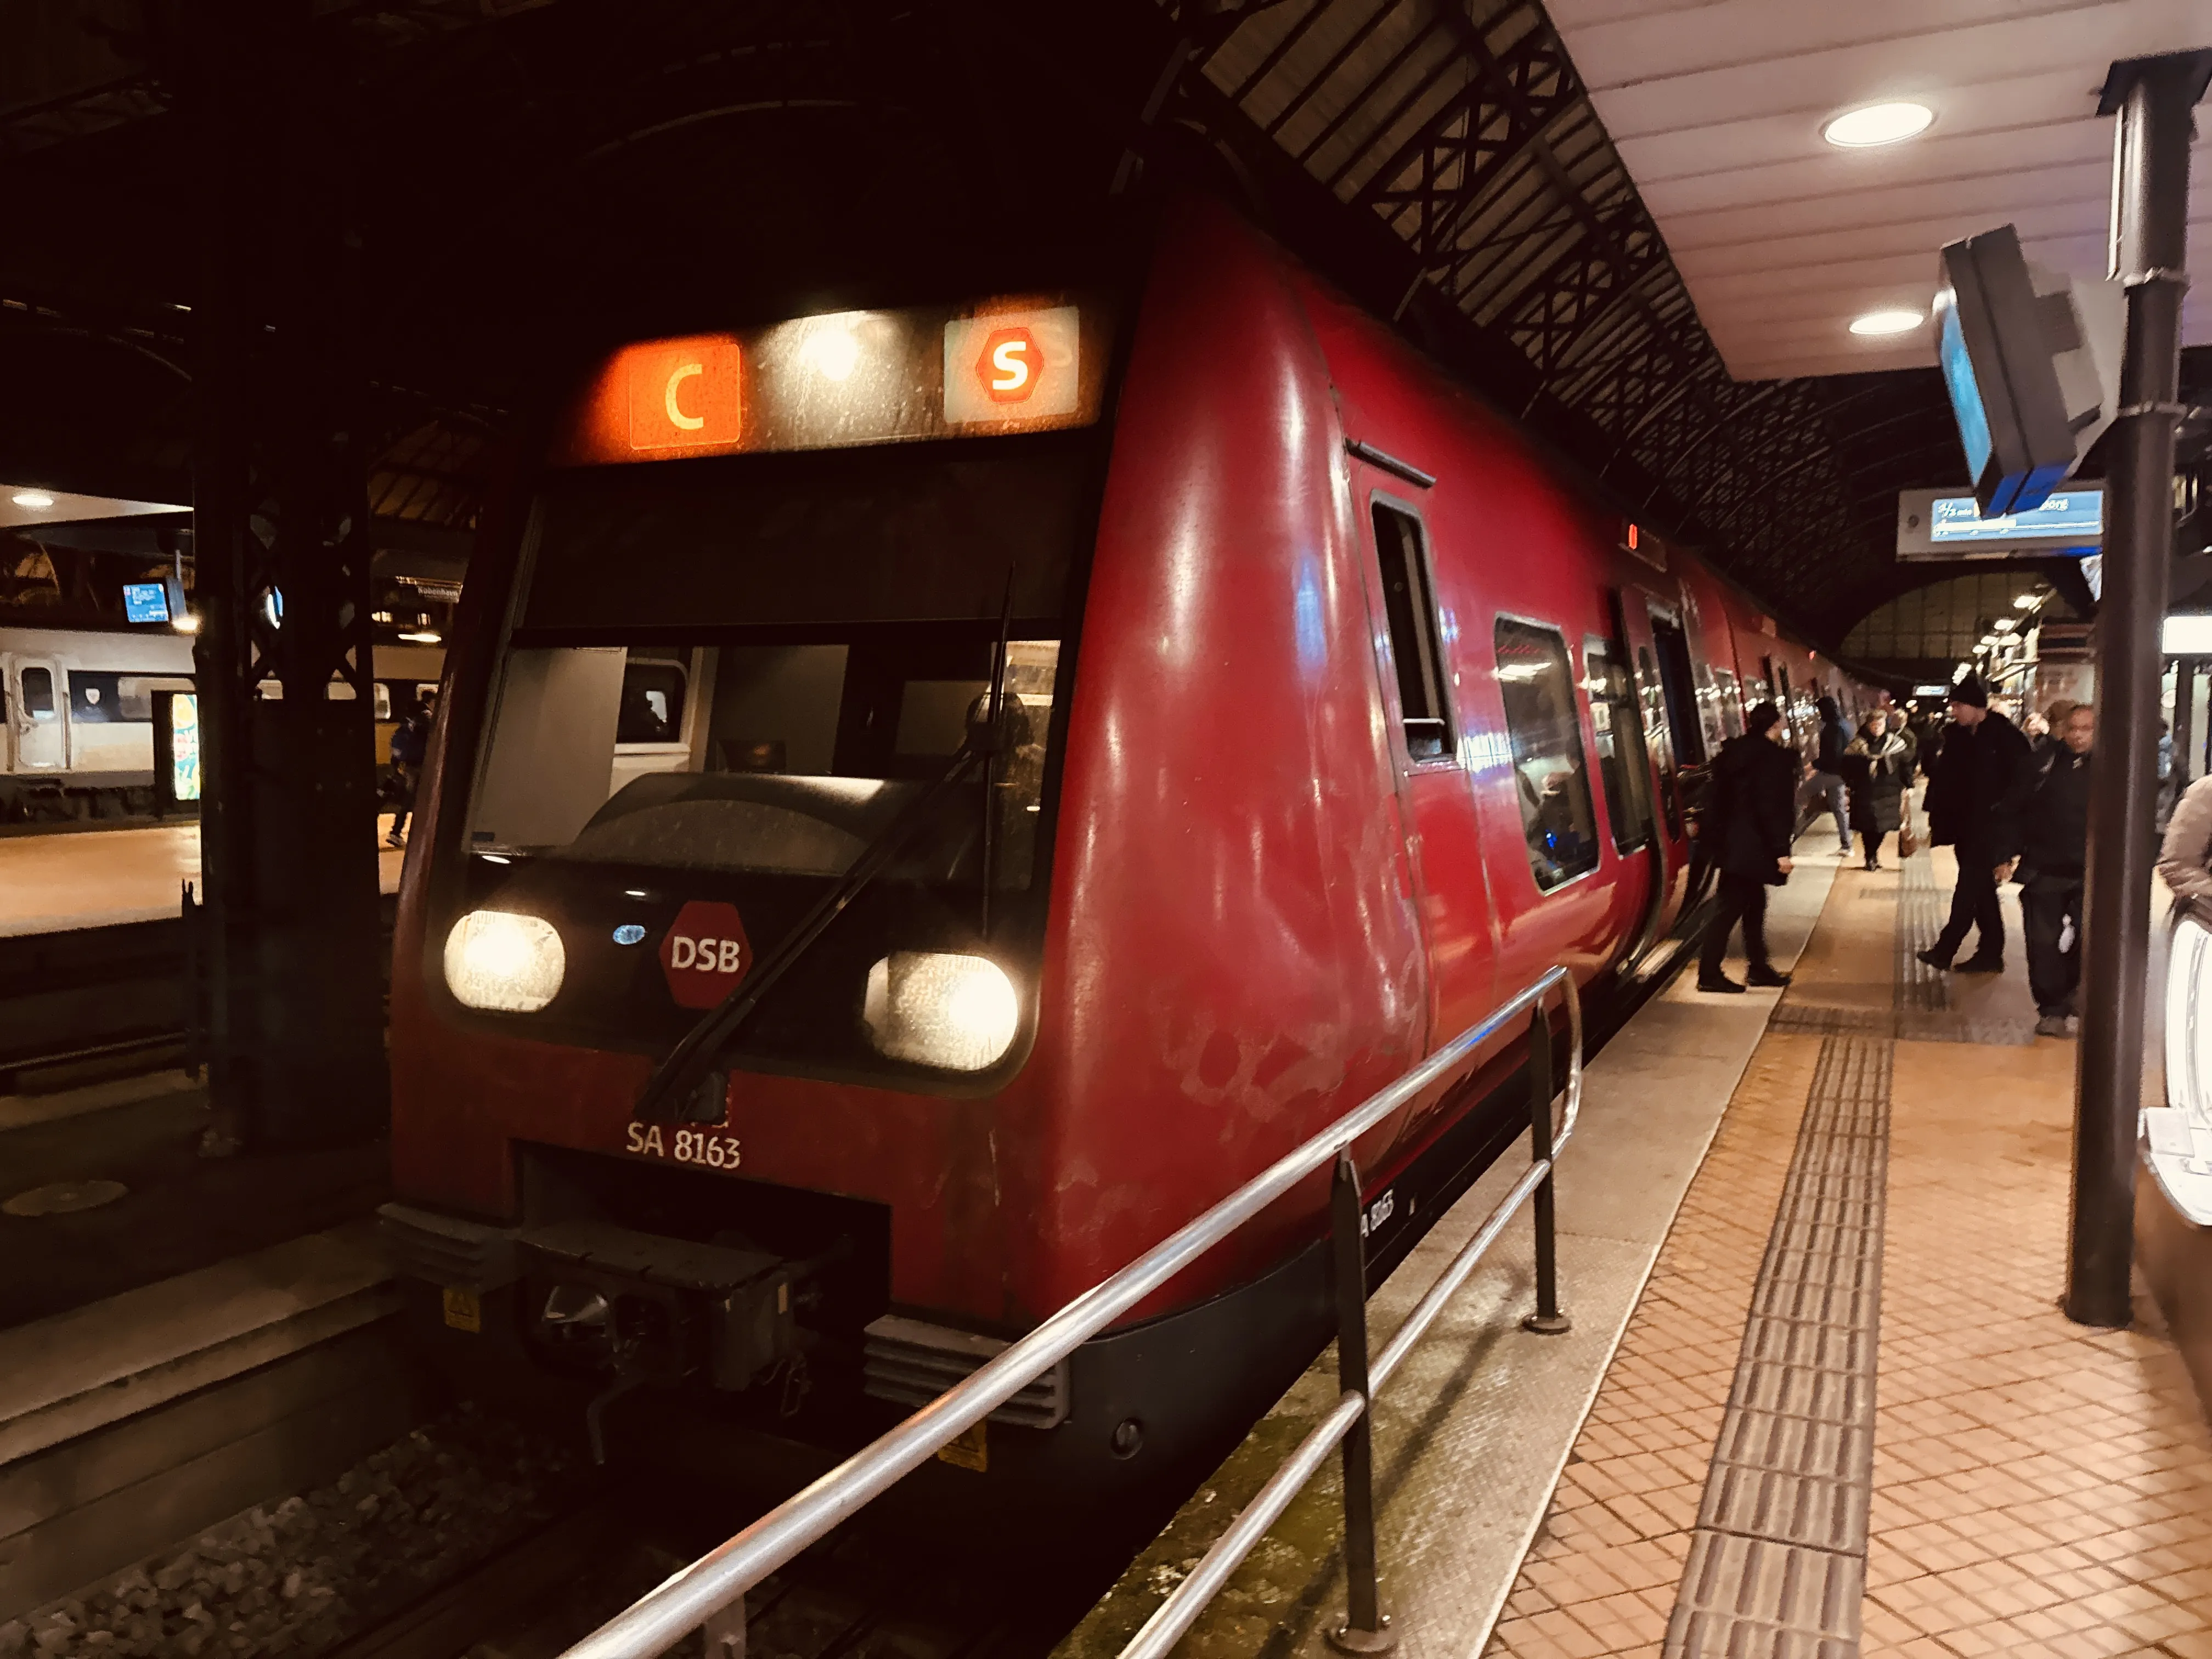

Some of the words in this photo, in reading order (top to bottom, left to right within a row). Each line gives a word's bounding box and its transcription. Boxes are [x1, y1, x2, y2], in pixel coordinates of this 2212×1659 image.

[992, 341, 1028, 390] S
[665, 364, 703, 430] C
[672, 936, 740, 973] DSB
[627, 1121, 664, 1157] SA
[674, 1130, 741, 1169] 8163
